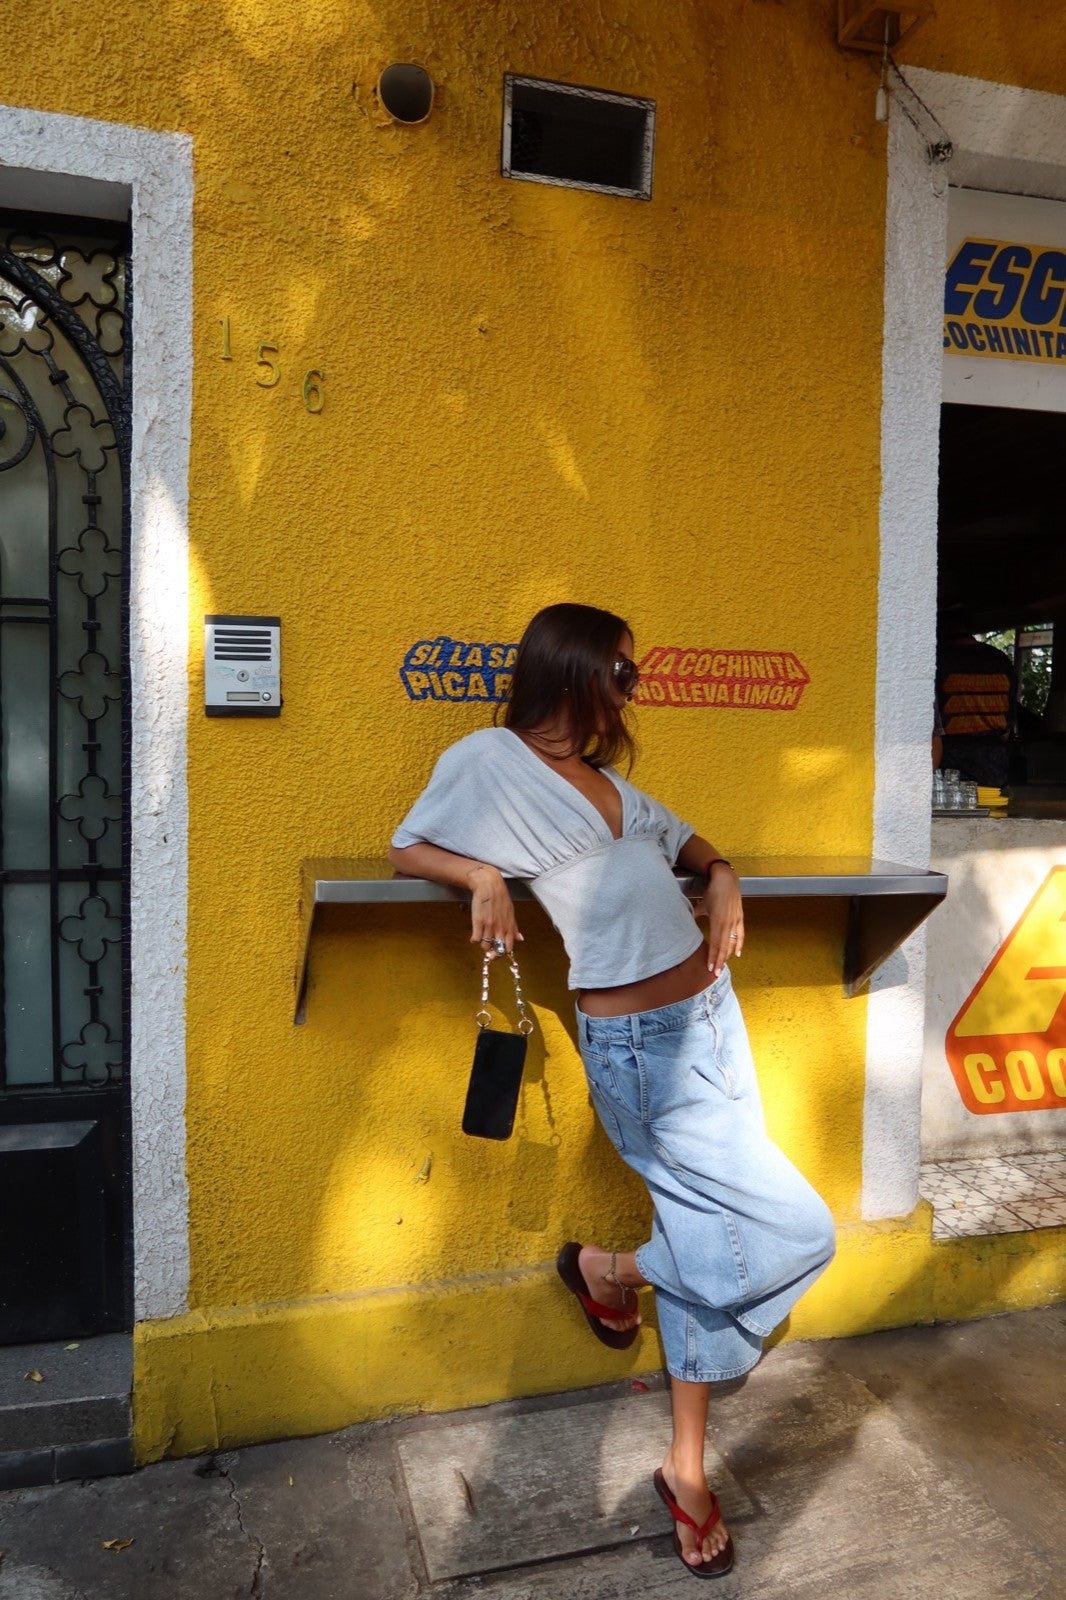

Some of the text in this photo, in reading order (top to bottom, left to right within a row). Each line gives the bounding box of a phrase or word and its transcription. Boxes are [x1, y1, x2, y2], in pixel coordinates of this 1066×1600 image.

[944, 242, 1066, 327] ESC
[449, 645, 484, 668] LA
[639, 651, 805, 679] LA COCHINITA
[405, 671, 489, 698] PICA
[637, 681, 800, 706] NO LLEVA LIMÓN
